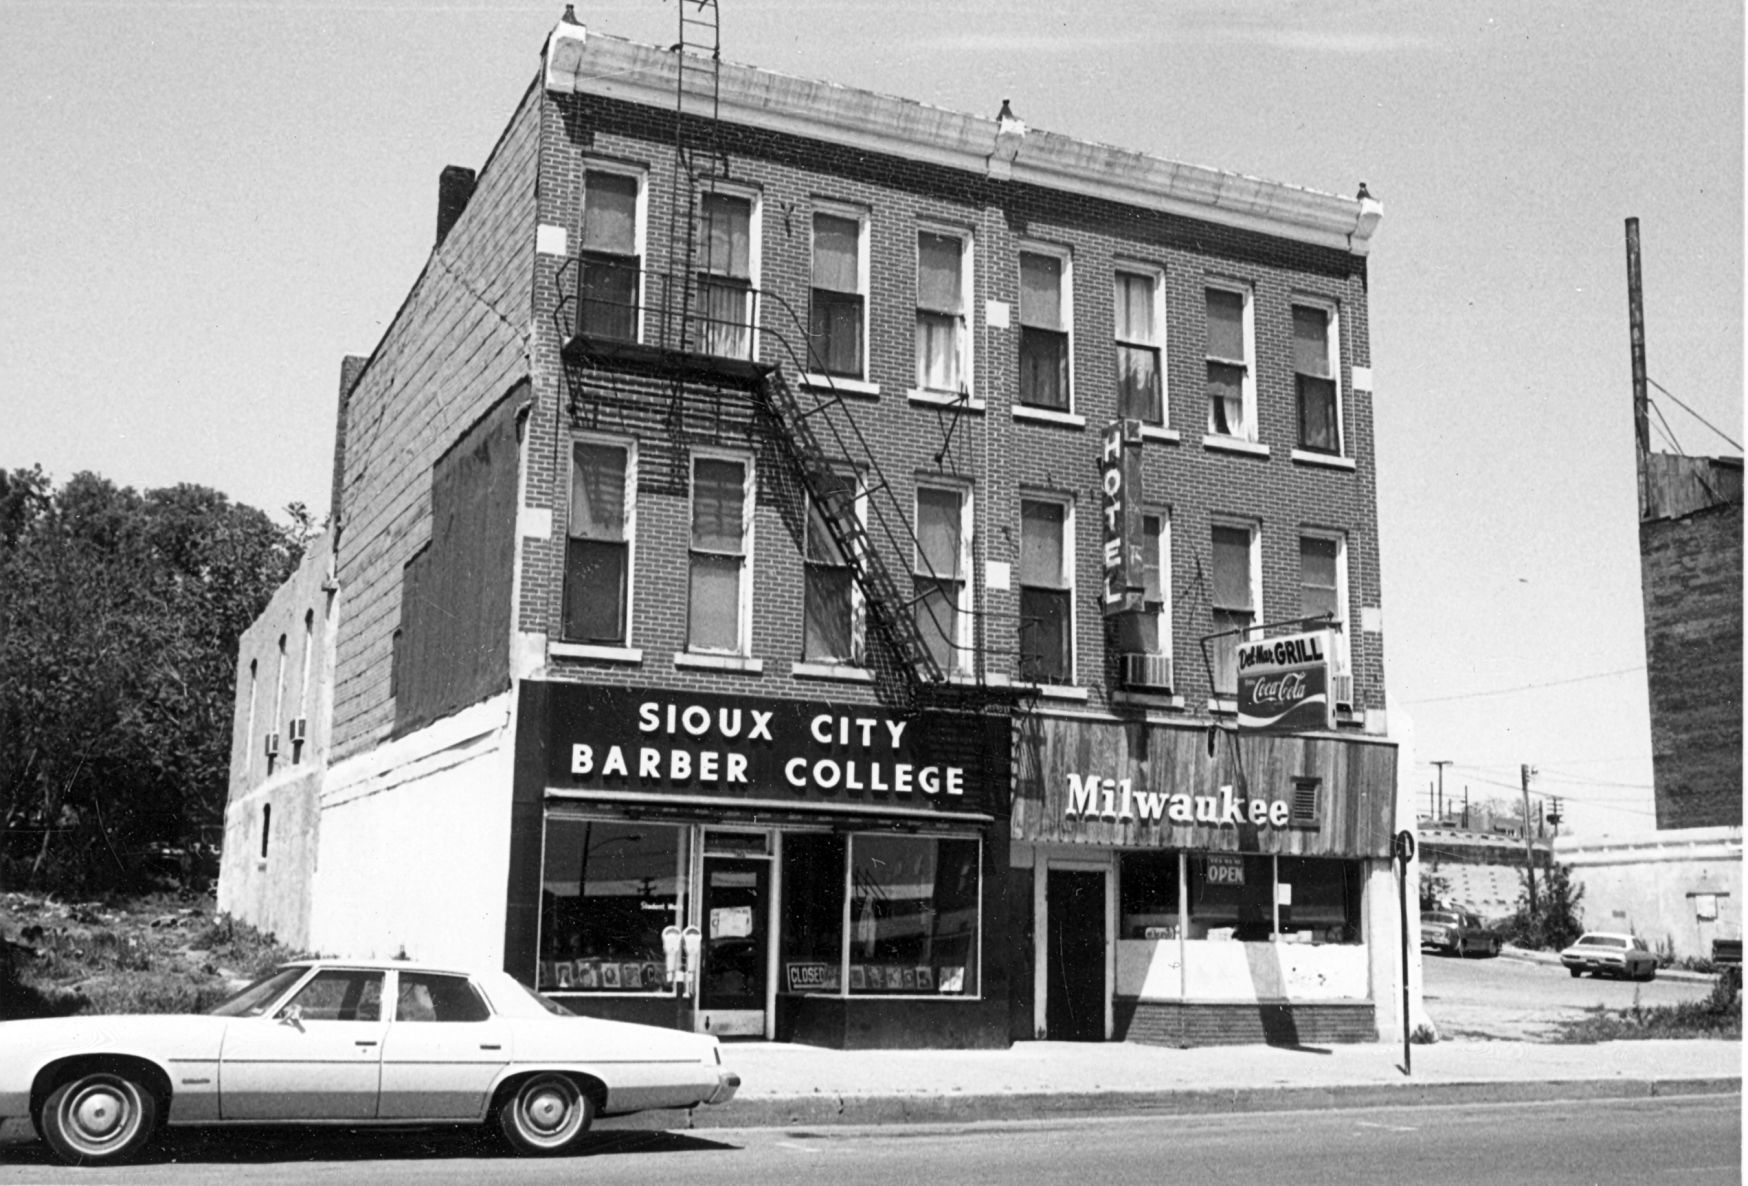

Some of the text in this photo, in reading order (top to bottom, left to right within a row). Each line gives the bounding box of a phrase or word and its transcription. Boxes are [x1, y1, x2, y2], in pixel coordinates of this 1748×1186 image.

[1104, 431, 1123, 605] HOTEL
[1274, 637, 1324, 666] GRILL
[638, 702, 907, 749] SIOUX CITY
[571, 743, 964, 796] BARBER COLLEGE
[1065, 773, 1289, 828] Milwaukee
[1209, 865, 1243, 882] OPEN
[790, 967, 825, 984] CLOSED
